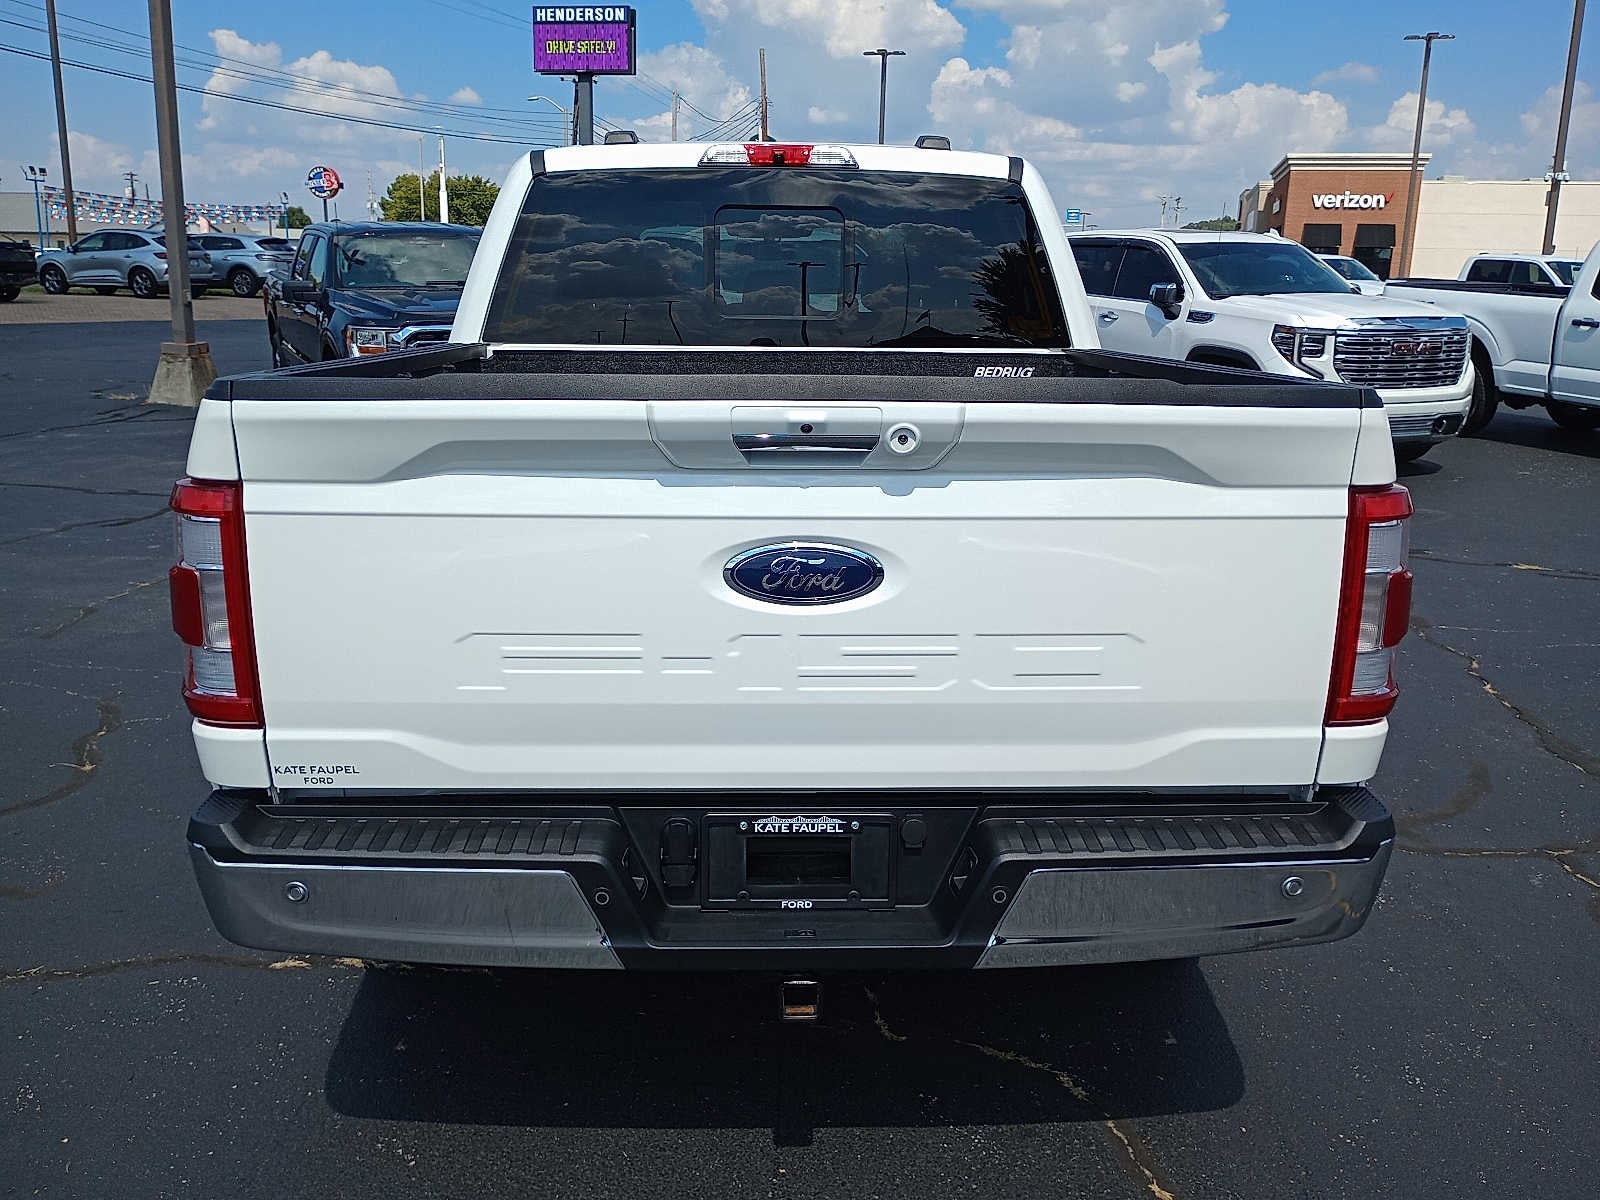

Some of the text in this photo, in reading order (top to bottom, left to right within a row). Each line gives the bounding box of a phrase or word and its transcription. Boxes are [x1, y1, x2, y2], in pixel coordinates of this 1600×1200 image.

[536, 8, 625, 21] HENDERSON
[546, 40, 616, 54] DRIVE SAFELY!
[1312, 190, 1386, 209] verizon
[974, 366, 1034, 378] BEDRUG
[762, 555, 847, 592] Ford
[274, 765, 360, 775] KATE FAUPEL
[303, 777, 334, 785] FORD
[754, 823, 844, 833] KATE FAUPEL
[781, 900, 813, 909] FORD
